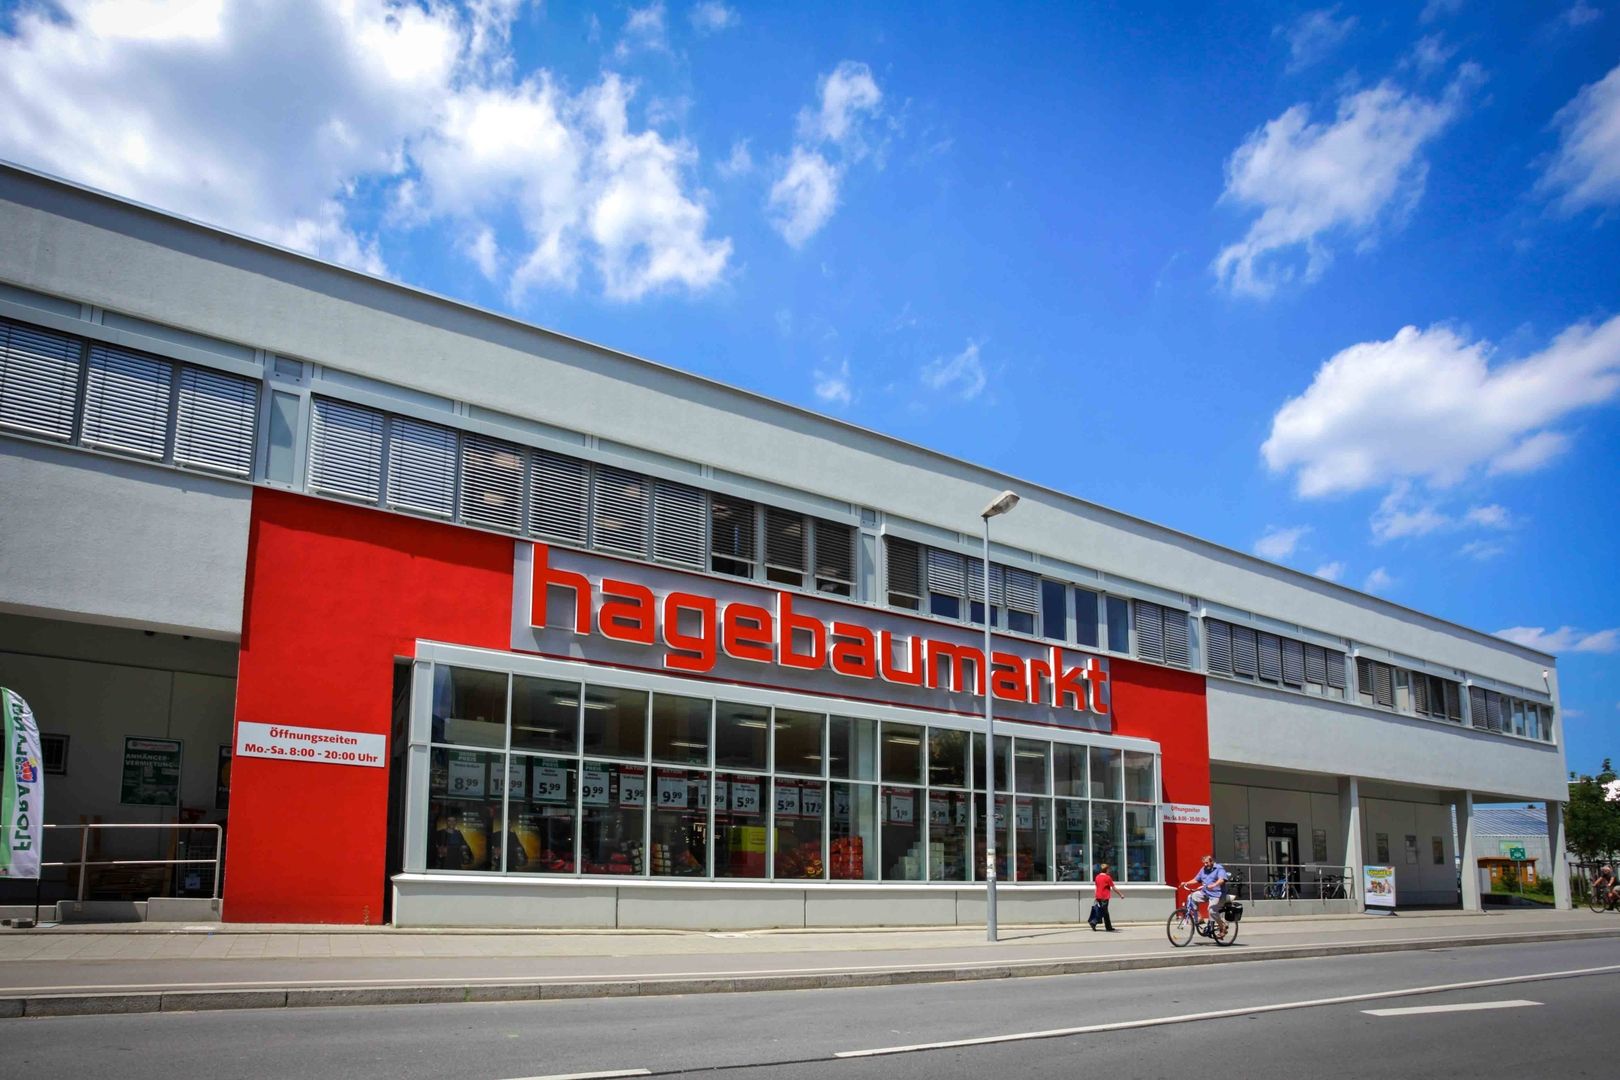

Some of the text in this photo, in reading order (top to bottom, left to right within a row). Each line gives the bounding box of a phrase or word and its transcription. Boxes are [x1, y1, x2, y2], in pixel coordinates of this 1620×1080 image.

[529, 542, 1107, 714] hagebaumarkt
[270, 727, 357, 744] Öffnungszeiten
[289, 748, 314, 757] 8:00
[324, 750, 355, 760] 20:00
[358, 753, 378, 762] Uhr
[539, 782, 560, 794] 5.99
[583, 785, 603, 797] 9.99
[662, 791, 682, 802] 9.99
[737, 795, 754, 807] 5.99
[777, 800, 794, 810] 5.99
